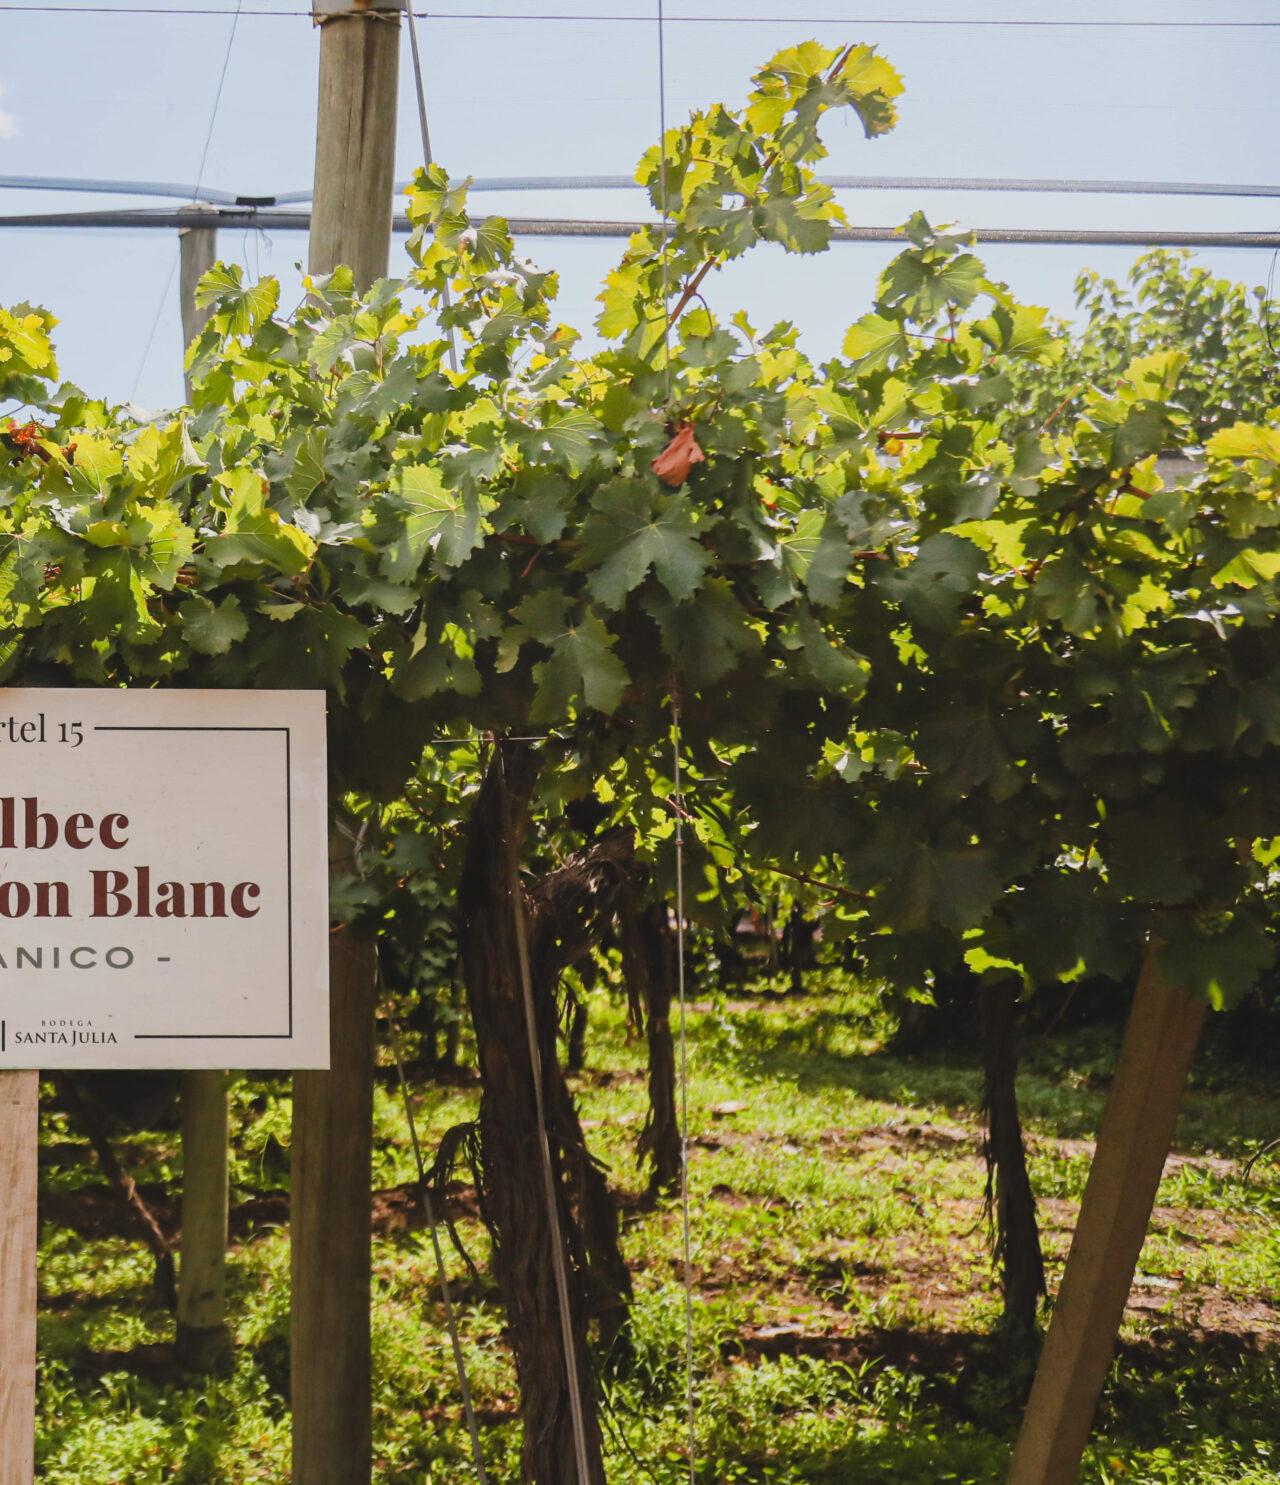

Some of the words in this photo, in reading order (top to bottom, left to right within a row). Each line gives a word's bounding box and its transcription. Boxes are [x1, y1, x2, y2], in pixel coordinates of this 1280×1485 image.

[57, 721, 84, 748] 15
[88, 865, 261, 919] Blanc
[41, 1019, 93, 1027] BODEGA
[14, 1031, 68, 1044] SANTA
[71, 1030, 118, 1047] JULIA
